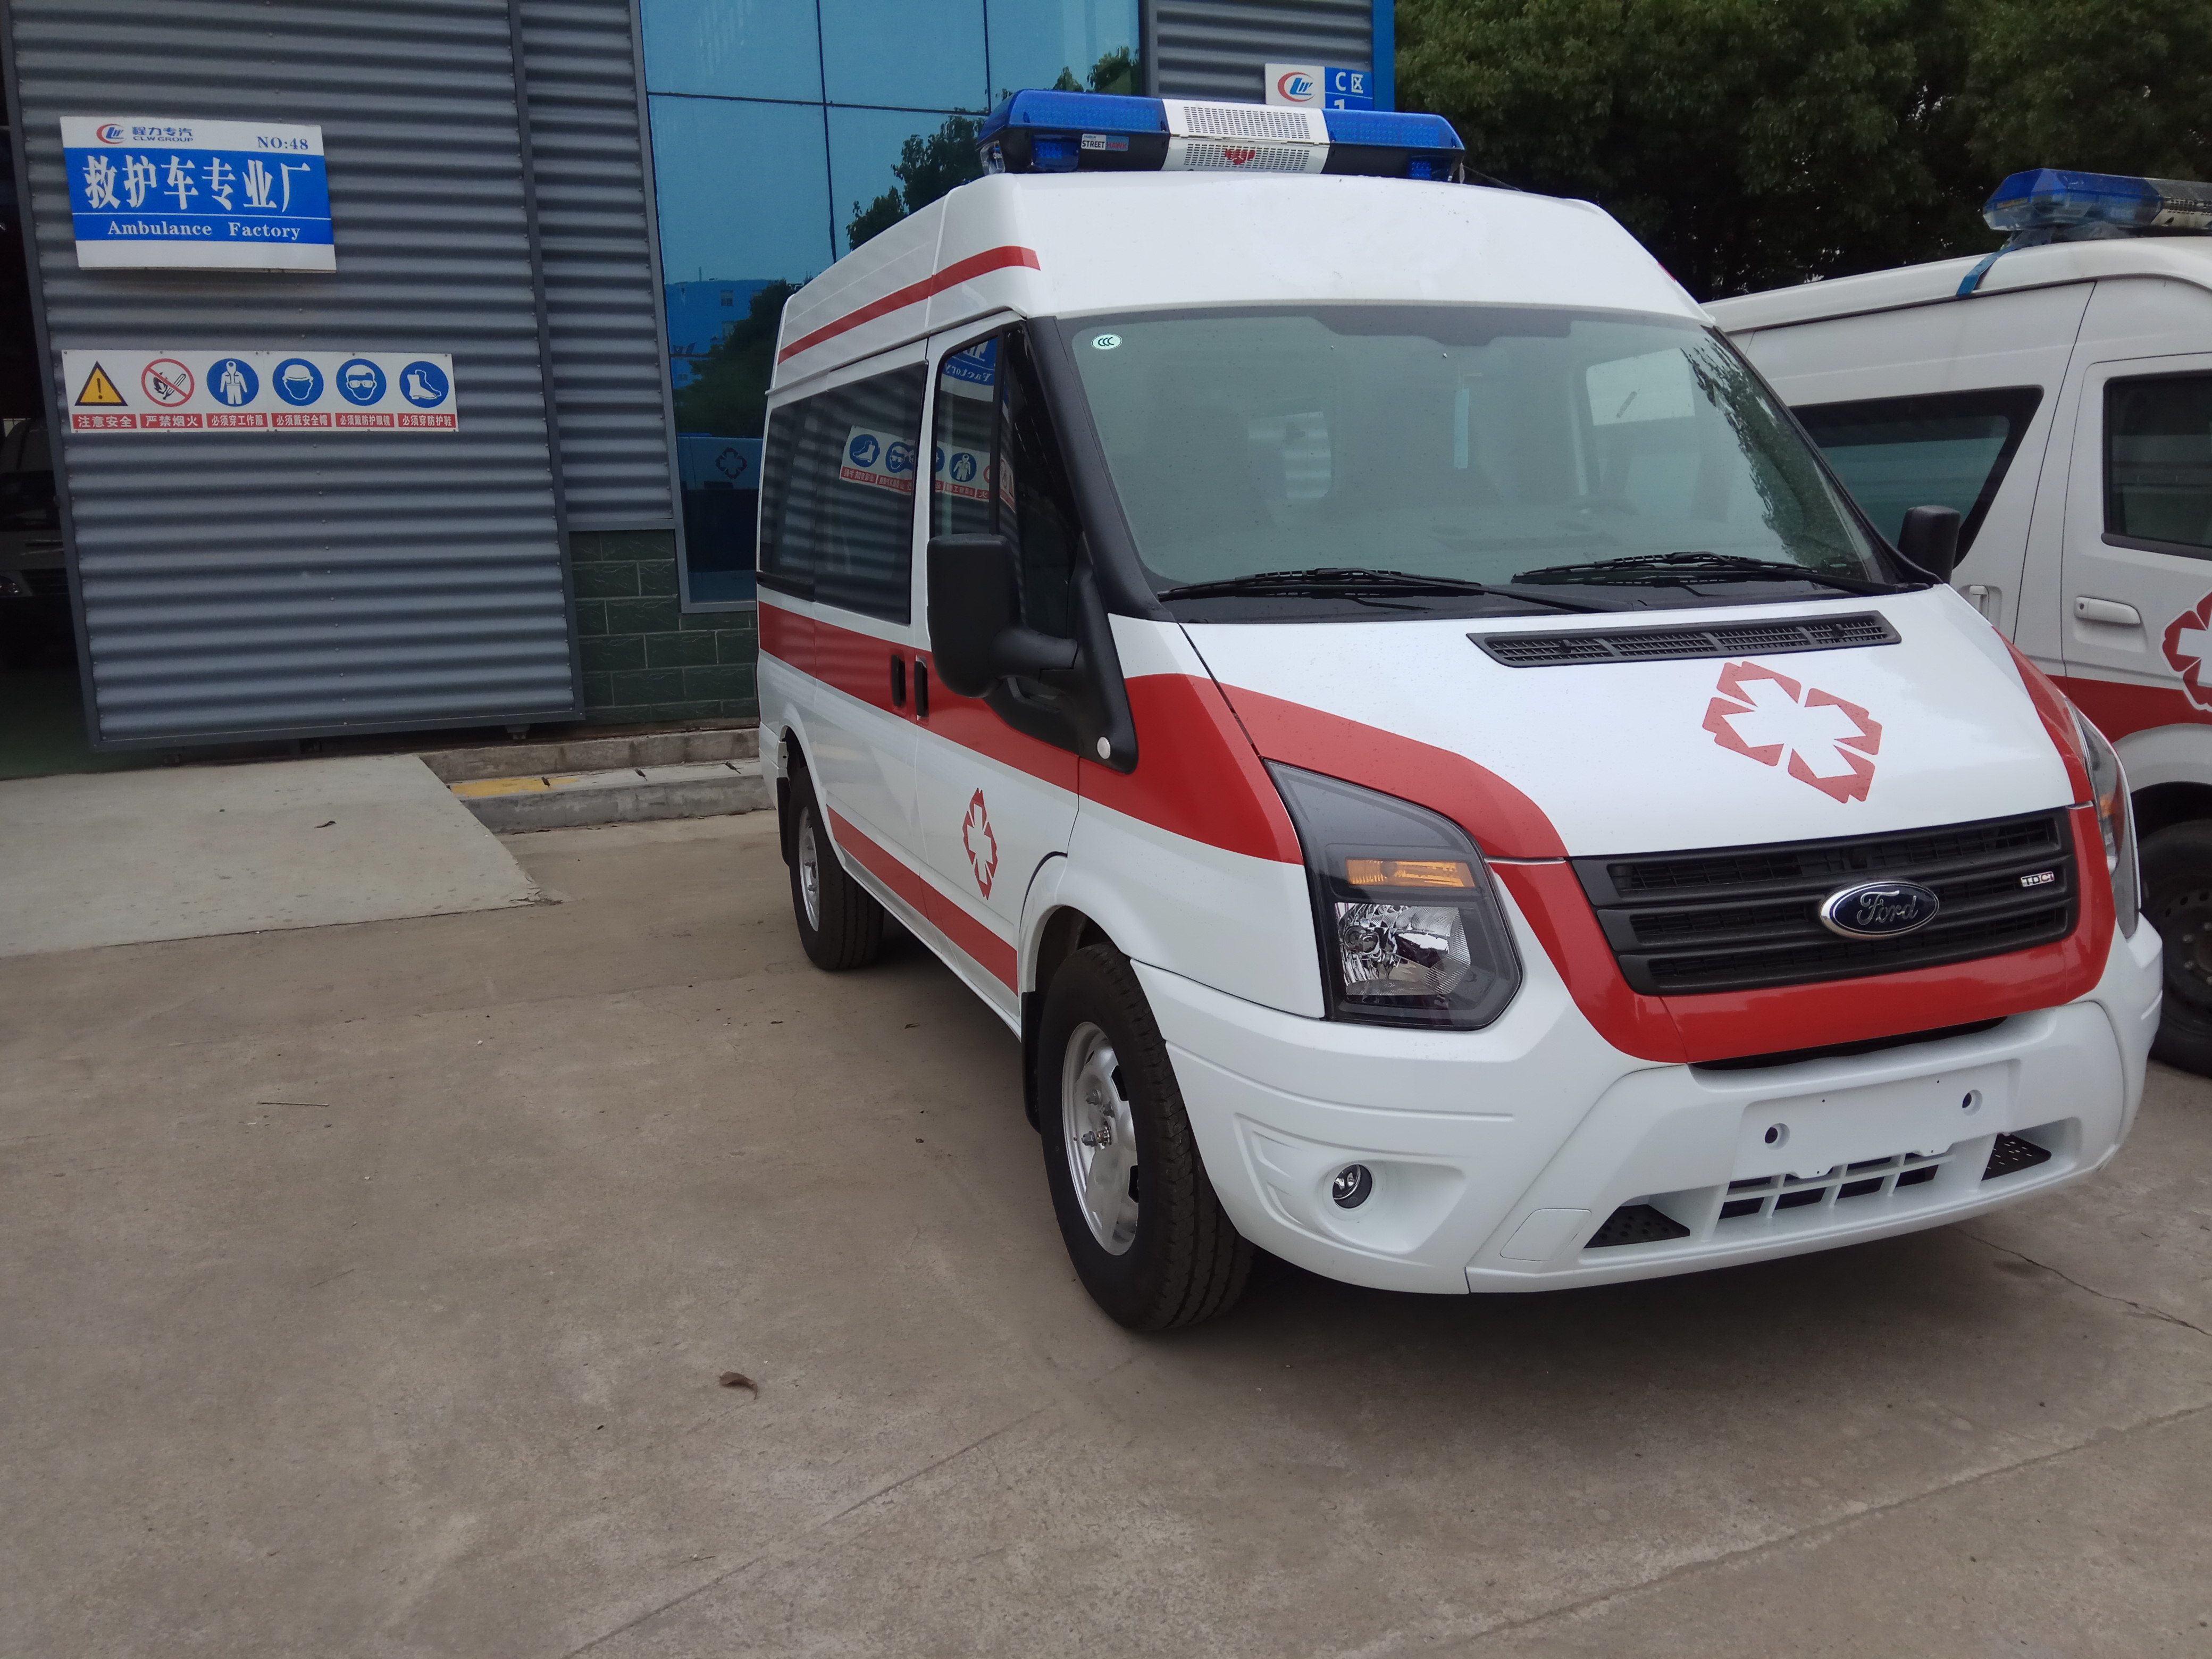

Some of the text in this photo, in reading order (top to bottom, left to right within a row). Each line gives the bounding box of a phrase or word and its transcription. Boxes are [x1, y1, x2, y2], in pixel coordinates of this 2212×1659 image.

[1335, 71, 1364, 94] C 区
[132, 126, 194, 137] 程力专汽
[257, 136, 308, 150] NO:48
[1082, 140, 1105, 148] STREET
[82, 155, 311, 213] 救护车专业厂
[107, 221, 300, 240] Ambulance Factory
[78, 415, 132, 428] 注意安全
[146, 415, 199, 427] 严禁烟火
[211, 415, 264, 426] 必须穿工作服
[276, 415, 328, 426] 必须戴安全帽
[340, 415, 391, 426] 必须戴防护眼镜
[403, 415, 452, 426] 必须穿防护鞋
[1856, 890, 1918, 926] Ford
